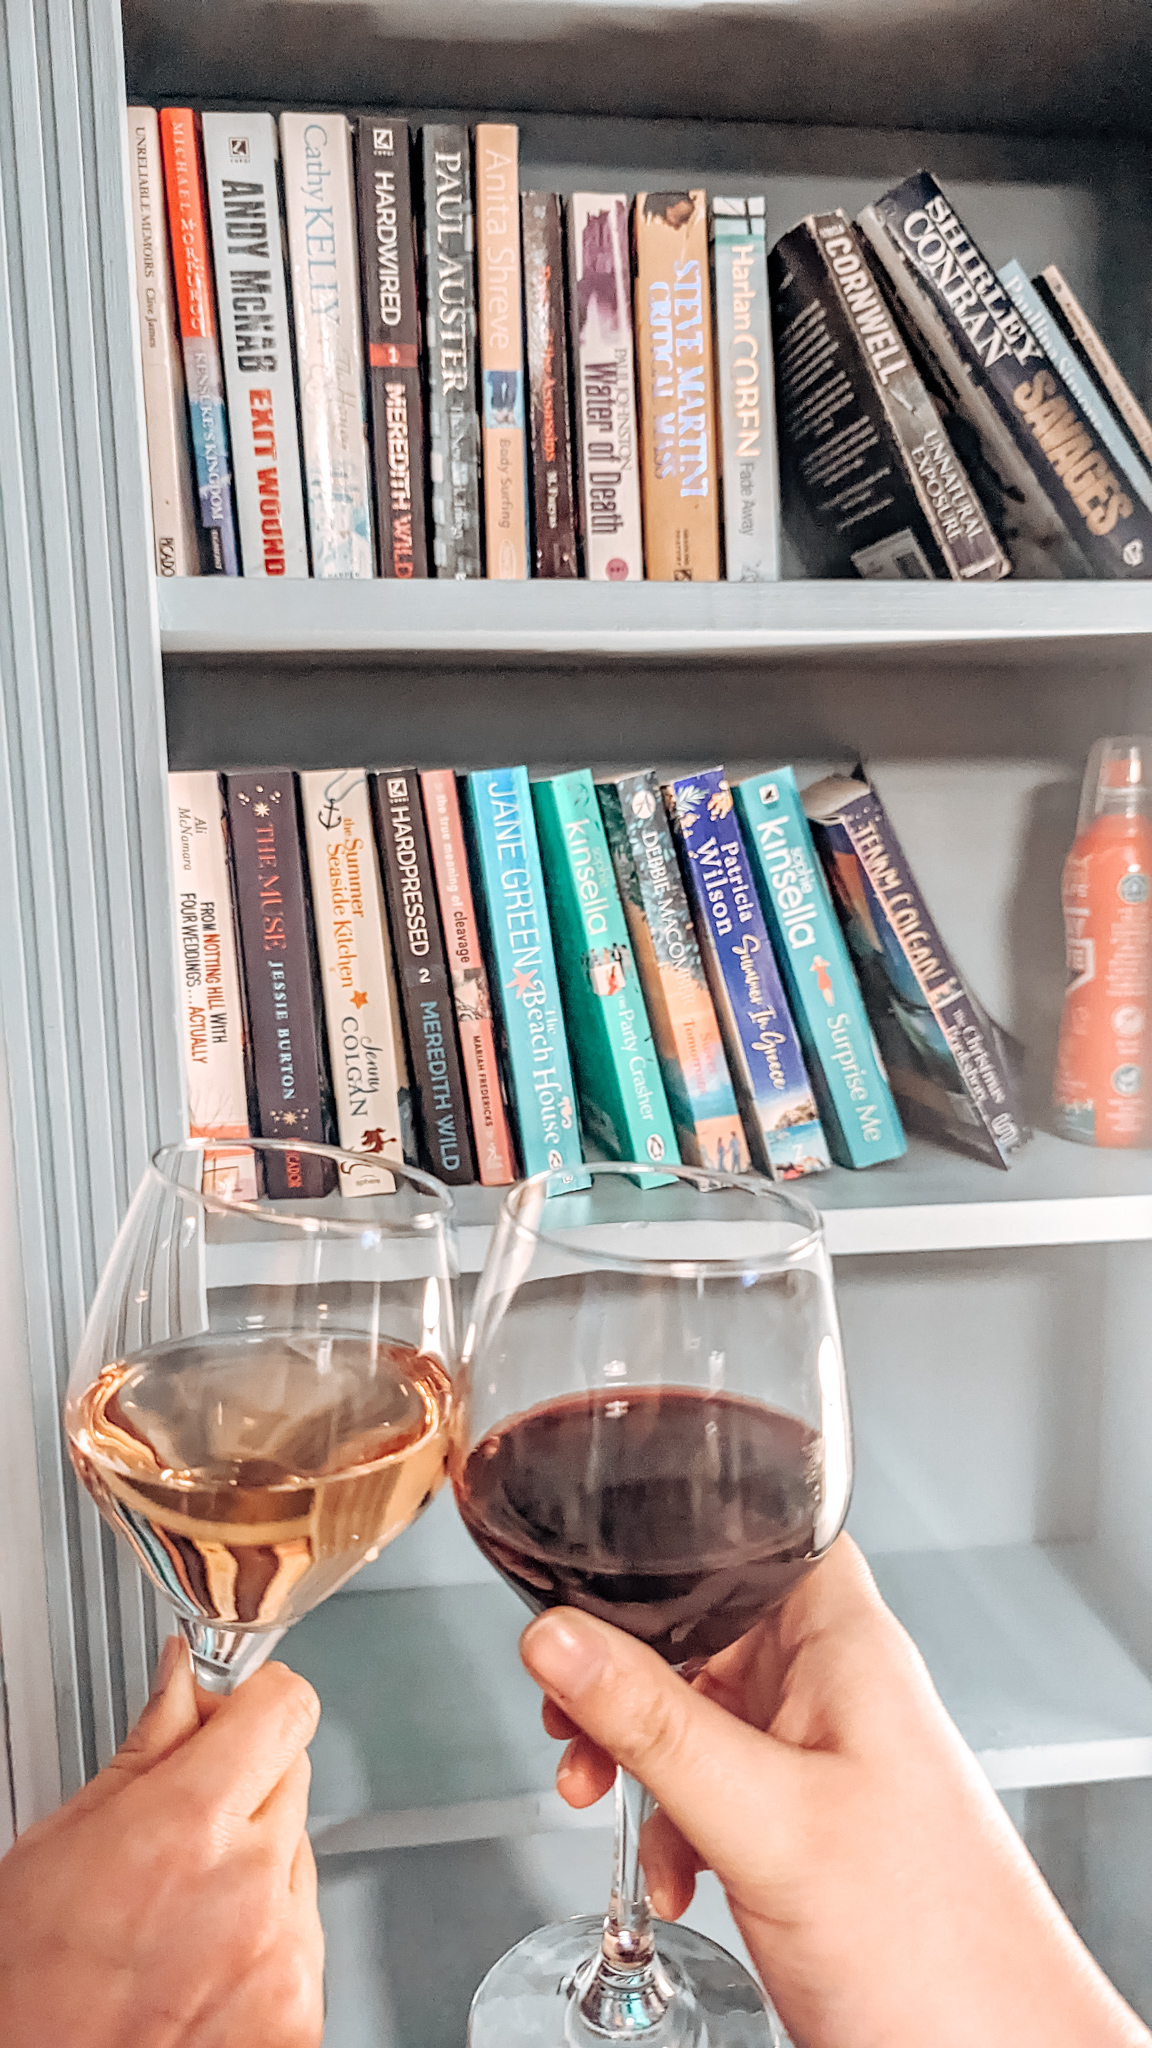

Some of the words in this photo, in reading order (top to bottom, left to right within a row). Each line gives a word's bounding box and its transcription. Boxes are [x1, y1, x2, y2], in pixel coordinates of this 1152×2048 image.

[135, 126, 151, 211] UNRELIABLE
[172, 122, 190, 212] MICHAEL
[300, 124, 331, 202] Cathy
[434, 151, 464, 243] PAUL
[485, 149, 514, 235] Anita
[141, 214, 154, 278] MEMOIRS
[222, 180, 270, 258] ANDY
[374, 170, 401, 326] HARDWIRED
[145, 287, 156, 314] Clive
[304, 205, 341, 326] KELLY
[487, 247, 518, 349] Shreve
[731, 244, 755, 330] Harlan
[903, 209, 1013, 369] CONRAN
[923, 195, 1045, 367] SHIRLEY
[146, 315, 158, 348] James
[438, 254, 468, 396] AUSTER
[674, 259, 704, 357] STEVE
[827, 236, 905, 385] CORNWELL
[585, 362, 618, 433] Water
[615, 348, 630, 384] PAUL
[249, 389, 277, 460] EXIT
[385, 382, 411, 510] MEREDITH
[498, 438, 512, 474] Body
[588, 442, 620, 462] of
[617, 386, 633, 471] JOHNSTON
[676, 365, 709, 497] MARTINI
[1014, 370, 1132, 535] SAVAGES
[204, 443, 224, 520] KINGDOM
[499, 478, 514, 529] Surfing
[589, 472, 624, 535] Death
[739, 463, 754, 497] Fade
[910, 444, 964, 545] EXPOSURE
[920, 429, 984, 541] UNNATURAL
[257, 468, 286, 577] WOUND
[392, 514, 413, 578] WILD
[738, 500, 756, 536] Away
[160, 537, 175, 577] PICADO
[178, 807, 193, 870] McNamara
[194, 817, 207, 834] Ali
[343, 818, 354, 837] the
[436, 794, 448, 814] the
[440, 816, 452, 839] true
[488, 782, 527, 860] JANE
[256, 824, 277, 869] THE
[326, 844, 348, 915] Seaside
[344, 838, 365, 918] Summer
[443, 843, 459, 892] meaning
[565, 819, 610, 935] kinsella
[642, 830, 670, 895] DEBBIE
[720, 841, 755, 923] Patricia
[757, 815, 817, 950] kinsella
[790, 847, 814, 894] sophie
[180, 893, 197, 923] FOUR
[200, 902, 217, 931] FROM
[258, 874, 287, 951] MUSE
[390, 806, 430, 956] HARDPRESSED
[419, 967, 431, 984] 2
[450, 895, 462, 907] of
[501, 869, 543, 968] GREEN
[696, 837, 734, 936] Wilson
[857, 820, 900, 890] JENNY
[889, 893, 944, 980] COLGAN
[203, 934, 222, 984] NOTTING
[332, 920, 357, 988] Kitchen
[453, 911, 471, 963] cleavage
[731, 933, 764, 1005] Summer
[207, 987, 225, 1010] HILL
[267, 960, 288, 1019] JESSIE
[523, 979, 554, 1062] Beach
[545, 1008, 558, 1034] The
[748, 1005, 776, 1031] In
[210, 1013, 228, 1043] WITH
[276, 1028, 295, 1100] BURTON
[361, 1036, 383, 1094] Jenny
[420, 1001, 451, 1110] MEREDITH
[618, 1009, 638, 1052] Party
[628, 1056, 655, 1120] Crasher
[751, 1031, 786, 1090] Greece
[960, 1022, 1007, 1104] Christmas
[342, 1016, 368, 1117] COLGAN
[473, 1035, 484, 1071] MARIAH
[479, 1073, 493, 1127] FREDERICKS
[827, 1013, 867, 1101] Surprise
[855, 1104, 882, 1143] Me
[435, 1114, 460, 1170] WILD
[532, 1067, 562, 1144] House
[285, 1148, 302, 1188] ICADOR
